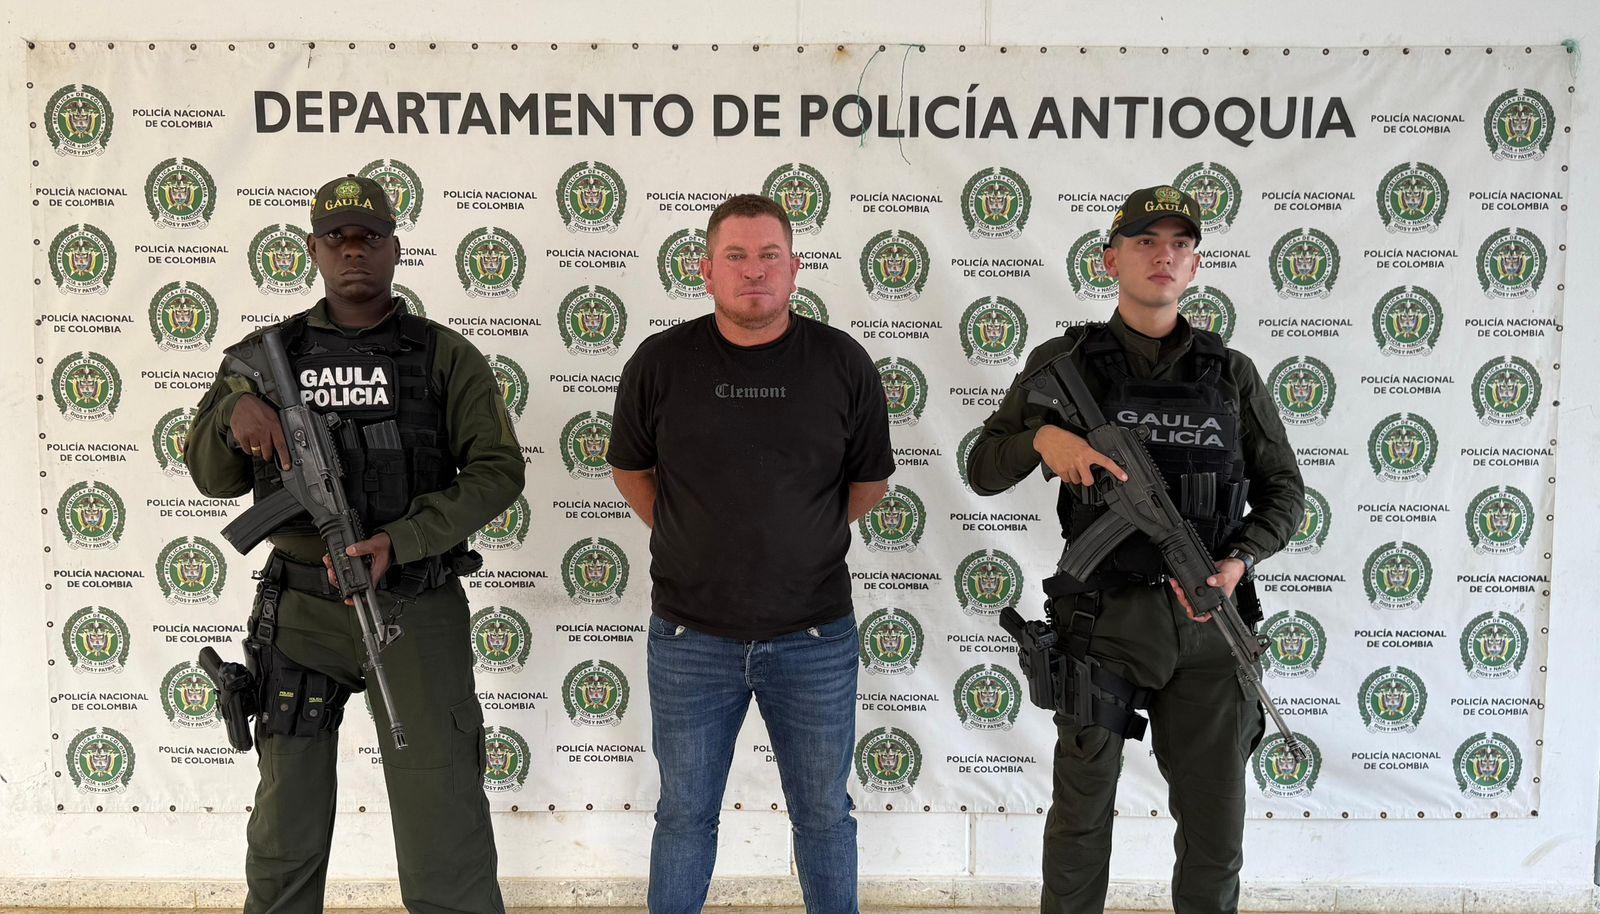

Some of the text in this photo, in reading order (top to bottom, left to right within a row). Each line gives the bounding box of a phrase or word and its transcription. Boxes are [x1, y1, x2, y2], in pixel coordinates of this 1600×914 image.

[133, 107, 226, 117] POLICÍA NACIONAL
[254, 83, 1356, 148] DEPARTAMENTO DE POLICÍA ANTIOQUIA
[1371, 113, 1410, 122] POLICÍA
[161, 120, 213, 128] COLOMBIA
[1399, 125, 1450, 133] COLOMBIA
[36, 187, 127, 196] POLICÍA NACIONAL
[237, 187, 317, 197] POLICÍA NACION
[444, 189, 483, 199] POLICÍA
[1262, 190, 1355, 200] POLICÍA NACIONAL
[851, 192, 943, 203] POLICÍA NACIONAL
[325, 198, 375, 211] GAULA
[472, 202, 524, 210] COLOMBIA
[878, 205, 929, 213] COLOMBIA
[1145, 201, 1191, 217] GAULA
[135, 244, 175, 253] POLICÍA
[546, 248, 585, 257] POLICÍA
[1364, 248, 1458, 258] POLICÍA NACIONAL
[165, 256, 216, 264] COLOMBIA
[952, 257, 1044, 267] POLICÍA NACIONAL
[41, 313, 79, 322] POLICÍA
[1259, 317, 1298, 326] POLICÍA
[851, 319, 889, 328] POLICÍA
[68, 325, 121, 333] COLOMBIA
[878, 331, 929, 339] COLOMBIA
[300, 367, 388, 388] GAULA
[1361, 374, 1400, 383] POLICÍA
[715, 383, 786, 398] Clemont
[300, 387, 389, 407] POLICIA
[1117, 410, 1221, 431] GAULA
[1151, 429, 1224, 448] LICÍA
[47, 441, 139, 452] POLICÍA NACIONAL
[1461, 446, 1553, 456] POLICÍA NACIONAL
[553, 500, 590, 509] POLICÍA
[1358, 502, 1396, 512] POLICÍA
[54, 569, 145, 578] POLICÍA NACIONAL
[851, 571, 889, 580] POLICÍA
[556, 623, 594, 632] POLICÍA
[1354, 628, 1393, 637] POLICÍA
[1367, 640, 1433, 648] DE COLOMBIA
[59, 692, 97, 700] POLICÍA
[856, 692, 887, 700] OLICÍA
[1291, 697, 1341, 705] NACIONAL
[1279, 708, 1328, 716] COLOMBIA
[557, 743, 594, 752] POLICÍA
[584, 755, 634, 763] COLOMBIA
[947, 754, 1036, 765] POLICÍA NACIONAL
[1352, 750, 1389, 760] POLICÍA
[974, 765, 1024, 773] COLOMBIA
[1379, 762, 1429, 770] COLOMBIA
